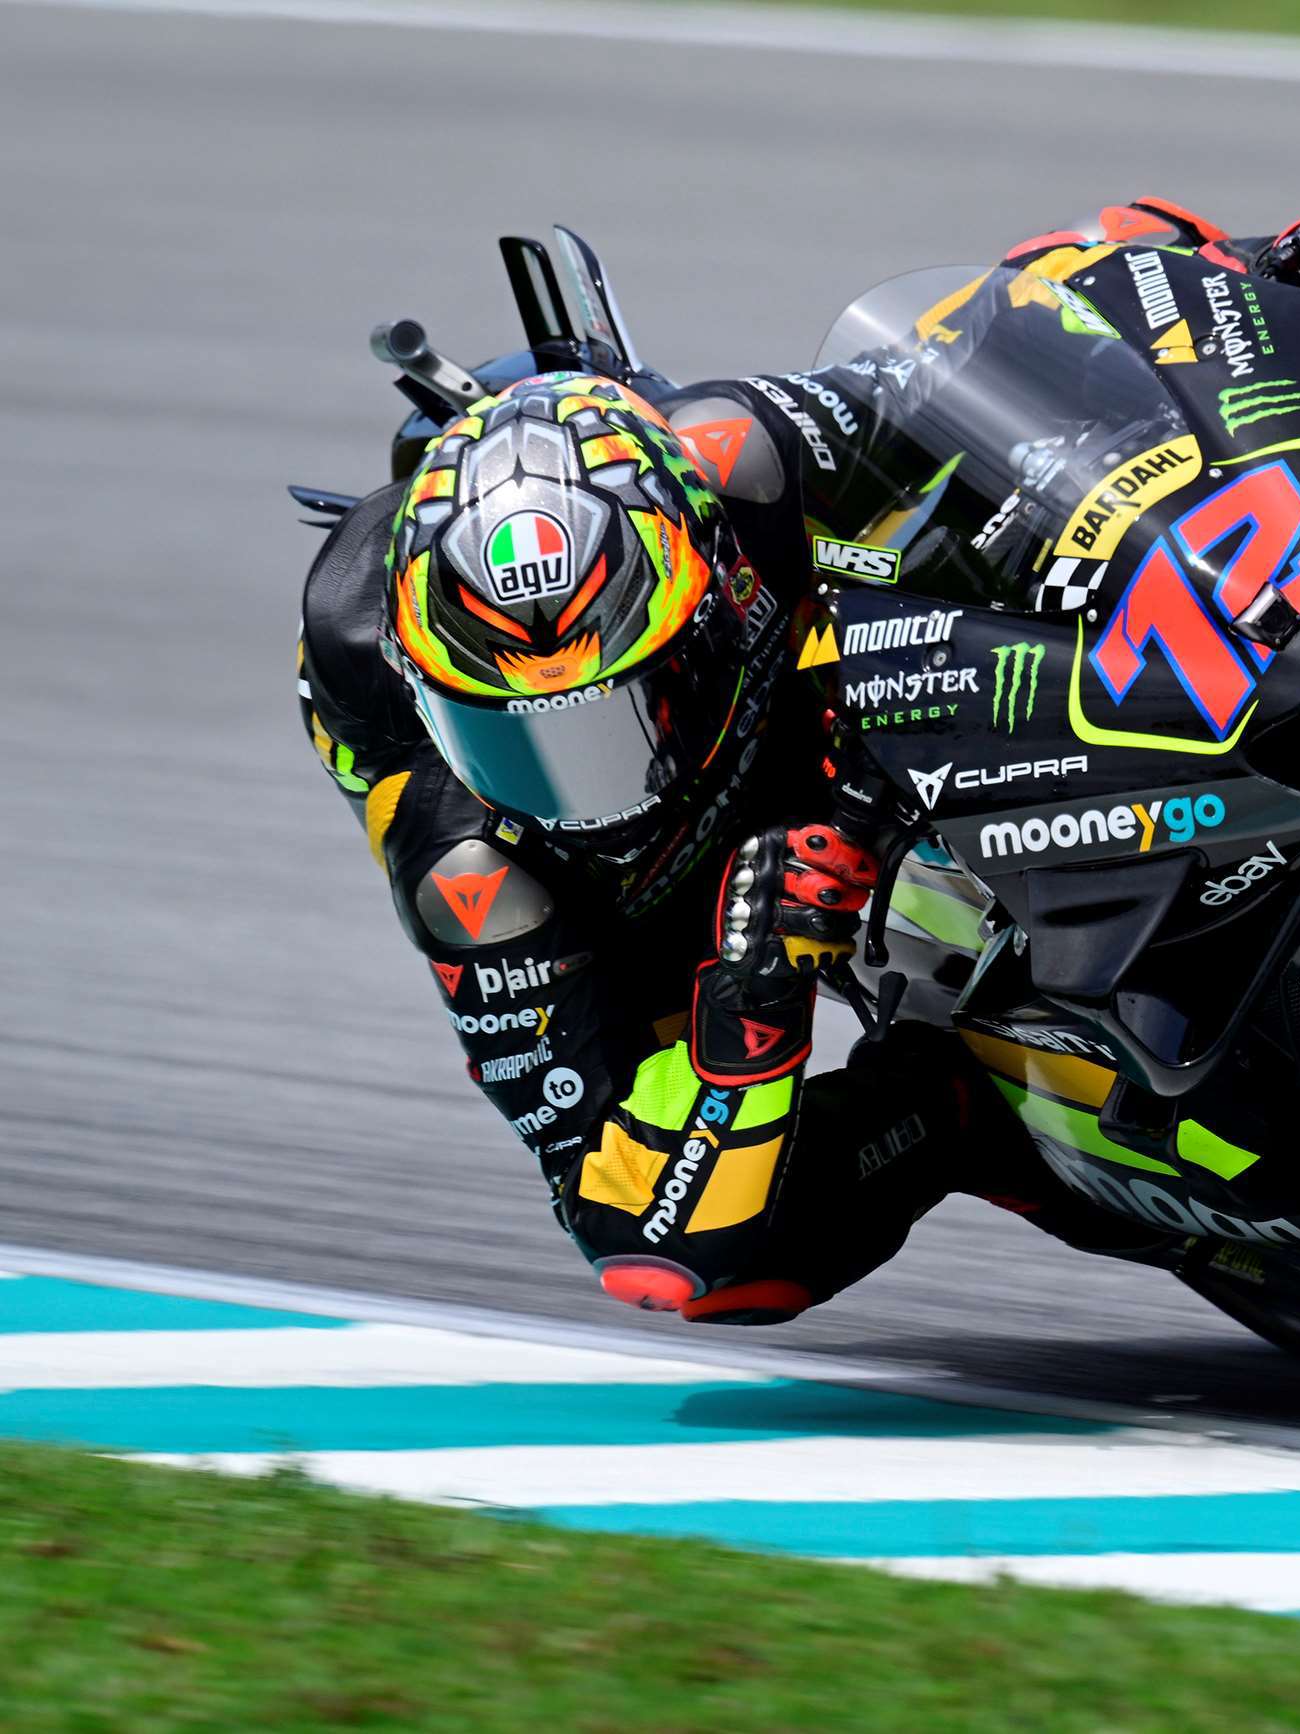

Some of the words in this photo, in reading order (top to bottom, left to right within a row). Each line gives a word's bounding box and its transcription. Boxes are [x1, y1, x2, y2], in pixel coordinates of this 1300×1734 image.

[1239, 281, 1275, 355] ENERGY
[1071, 448, 1195, 552] BARDAHL
[500, 556, 563, 597] agv
[816, 539, 897, 578] WRS
[507, 678, 615, 715] mooney
[861, 703, 959, 730] ENERGY
[955, 754, 1089, 790] CUPRA
[559, 795, 662, 831] CUPRA
[979, 793, 1226, 859] mooneygo
[1199, 840, 1289, 907] ebay
[548, 1079, 577, 1100] to
